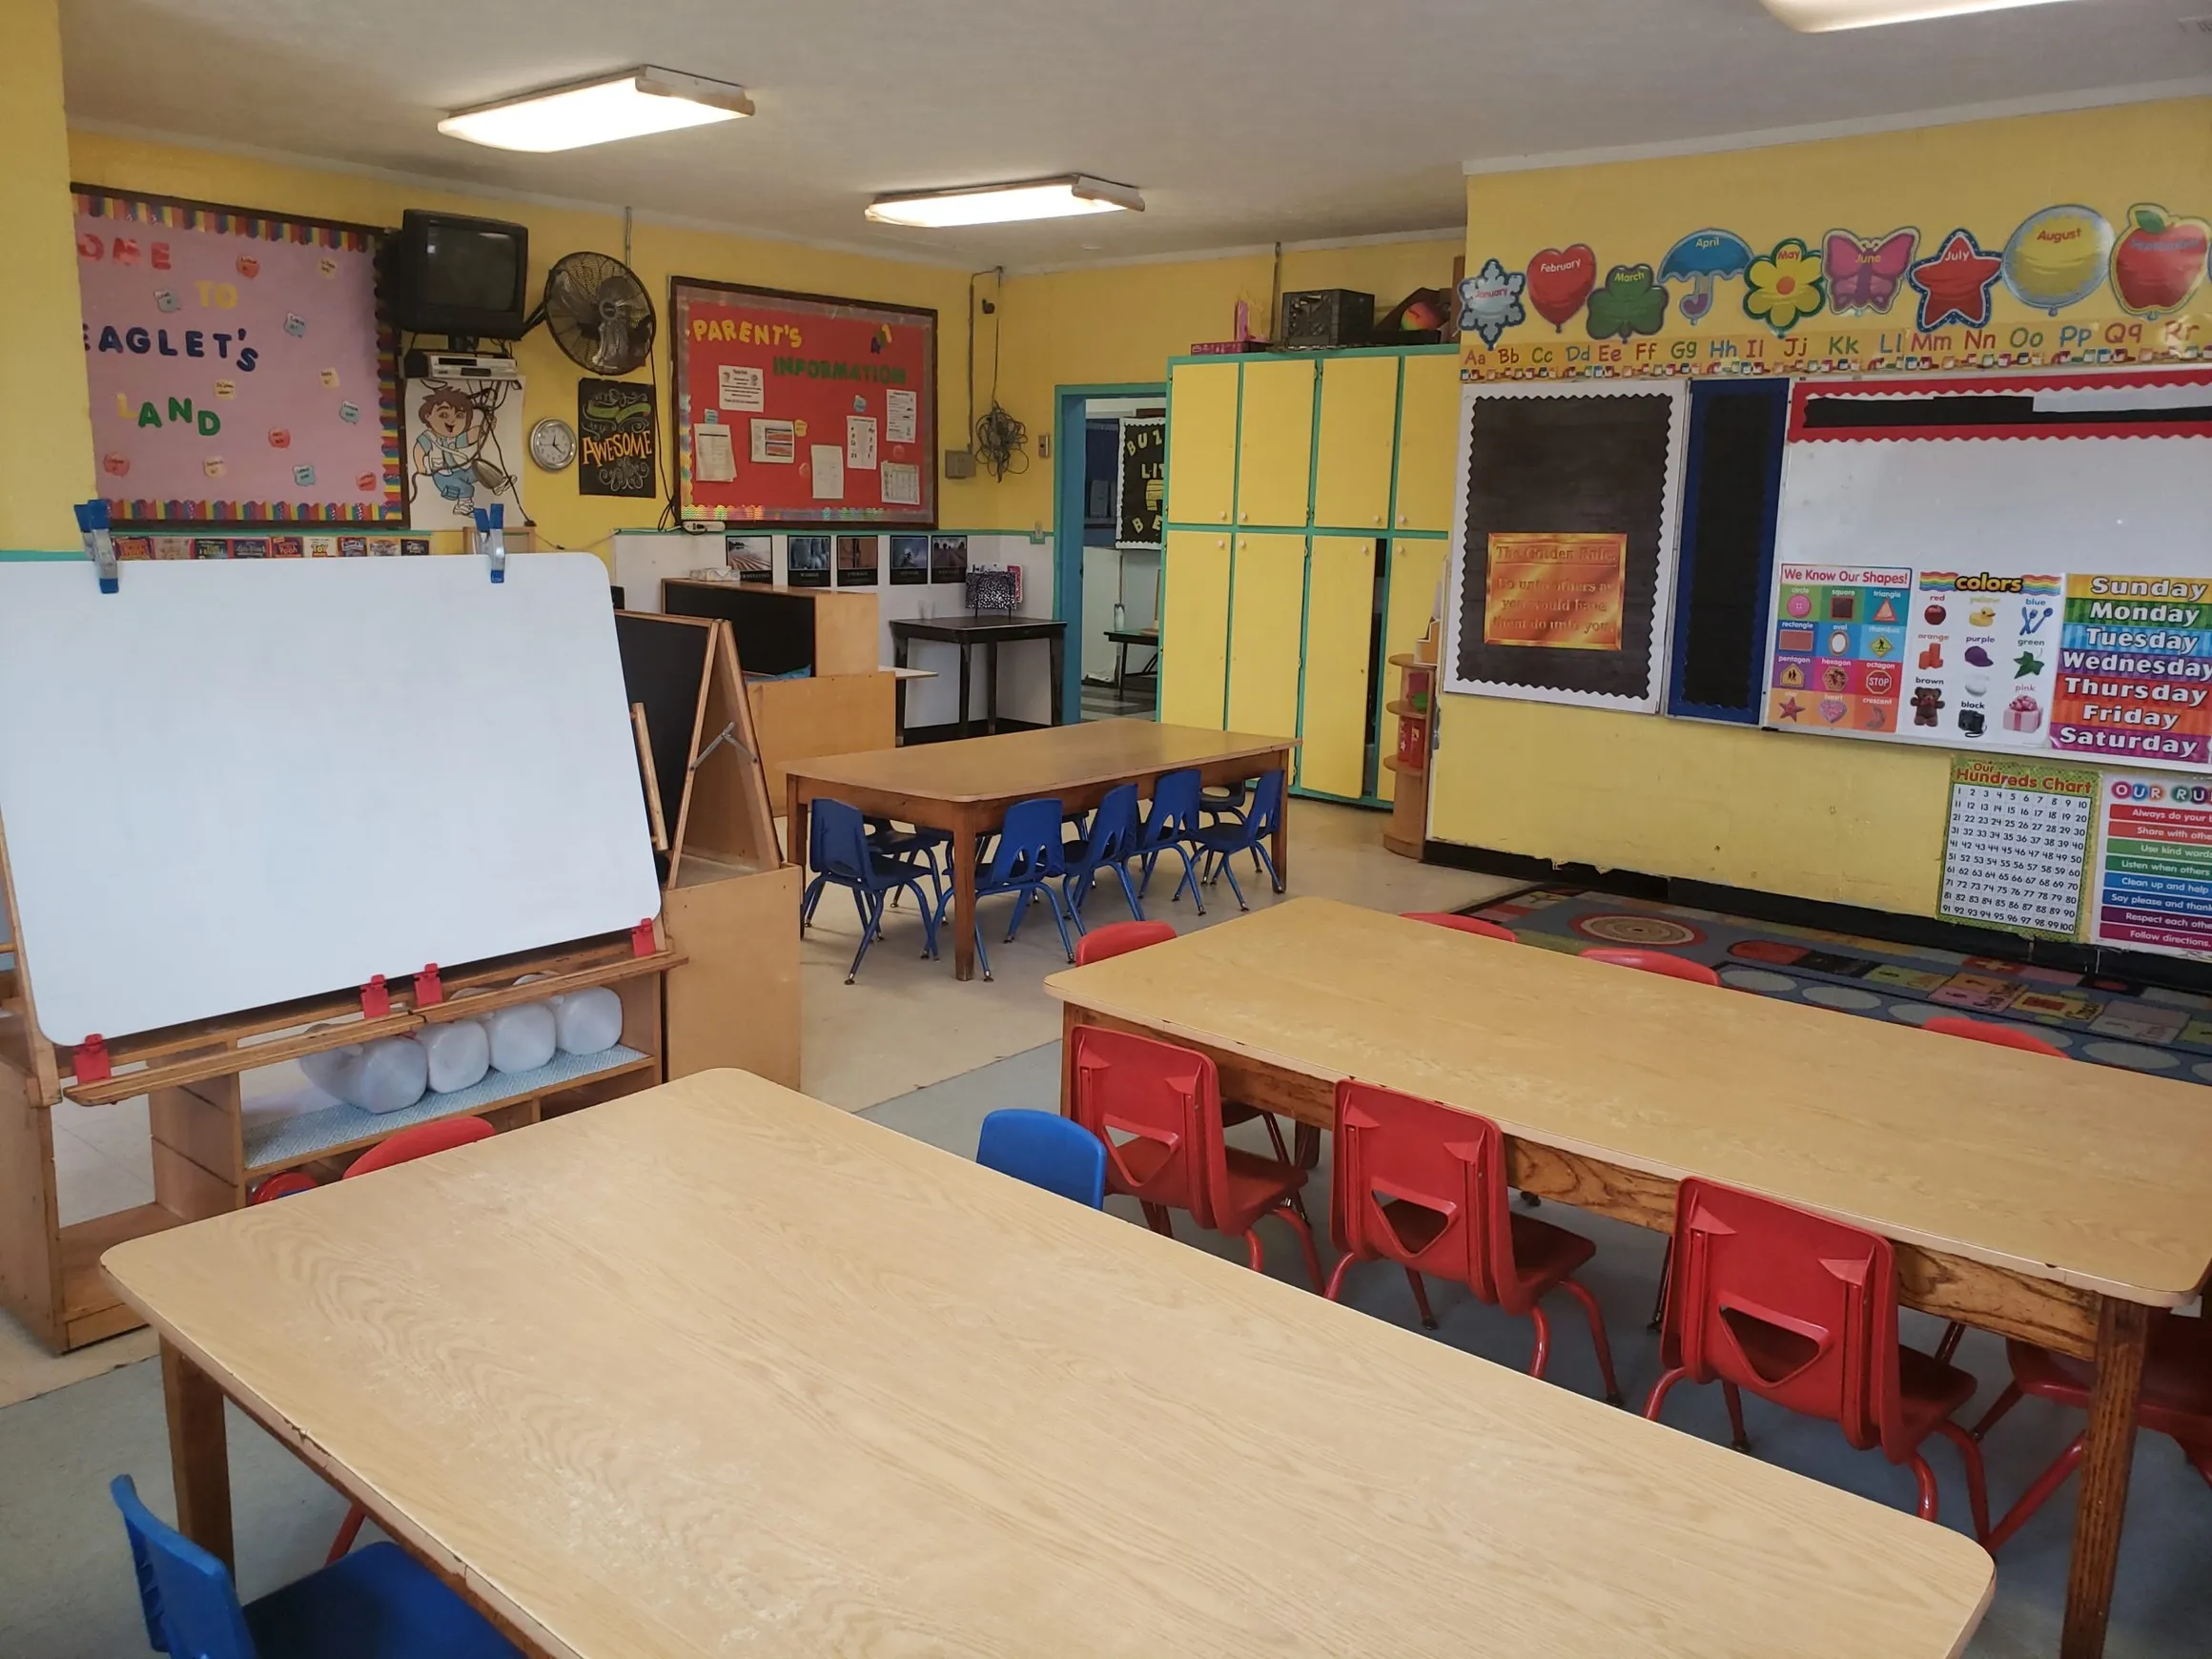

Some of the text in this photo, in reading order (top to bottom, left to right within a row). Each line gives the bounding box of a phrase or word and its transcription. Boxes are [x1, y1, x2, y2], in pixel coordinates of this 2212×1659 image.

[1695, 236, 1720, 249] April
[2037, 228, 2081, 244] August
[1777, 248, 1800, 261] May
[1854, 253, 1881, 264] June
[1944, 250, 1970, 262] July
[1540, 257, 1581, 274] February
[1613, 271, 1645, 284] March
[195, 279, 238, 310] TO
[1475, 286, 1507, 300] January
[692, 319, 803, 348] PARENT'S
[1464, 350, 1485, 365] Aa
[1499, 348, 1520, 364] Bb
[1531, 348, 1553, 362] Cc
[1566, 345, 1590, 361] Dd
[1598, 345, 1621, 361] Ee
[1635, 343, 1657, 360] Ff
[1670, 341, 1697, 359] Gg
[1710, 340, 1737, 358] Hh
[1784, 338, 1807, 358] Jj
[1829, 336, 1859, 355] Kk
[1911, 333, 1952, 352] Mm
[1964, 330, 1996, 350] Nn
[2010, 327, 2043, 348] Oo
[2059, 326, 2092, 349] Pp
[2104, 322, 2142, 344] Qq
[773, 356, 906, 385] INFORMATION
[115, 392, 221, 437] LAND
[582, 430, 652, 467] AWESOME
[1132, 515, 1162, 533] BE
[1784, 568, 1908, 585] We Know Our Shapes!
[1955, 571, 2023, 593] colors
[1832, 588, 1855, 597] square
[1874, 589, 1901, 599] triangle
[2091, 576, 2208, 602] Sunday
[2089, 602, 2201, 627] Monday
[1781, 621, 1813, 629] rectangle
[1917, 633, 1949, 642] orange
[1966, 635, 1996, 645] purple
[2086, 627, 2200, 654] Tuesday
[1778, 655, 1811, 665] pentagon
[1821, 657, 1851, 666] hexagon
[2062, 650, 2212, 682] Wednesday
[1869, 677, 1890, 686] STOP
[1915, 676, 1944, 686] brown
[2015, 684, 2036, 692] pink
[2064, 677, 2208, 707] Thursday
[1960, 701, 1985, 709] black
[2082, 705, 2180, 730] Friday
[2059, 727, 2199, 758] Saturday
[1973, 762, 1994, 773] Our
[1956, 768, 2093, 793] Hundreds Chart
[2116, 784, 2212, 801] OUR RU
[2132, 809, 2206, 822] Always do your
[2137, 826, 2164, 836] Share
[2167, 830, 2188, 838] with
[2140, 844, 2159, 852] Use
[2161, 846, 2181, 855] kind
[2121, 860, 2210, 876] Listen when others
[2121, 877, 2209, 895] Clean up and help
[2111, 893, 2128, 903] Say
[2131, 896, 2162, 906] please
[2165, 900, 2183, 909] and
[1942, 905, 1950, 913] 91
[2061, 923, 2075, 932] 100
[2125, 911, 2162, 924] Respect
[2165, 917, 2188, 927] each
[2130, 930, 2211, 948] Follow directions.
